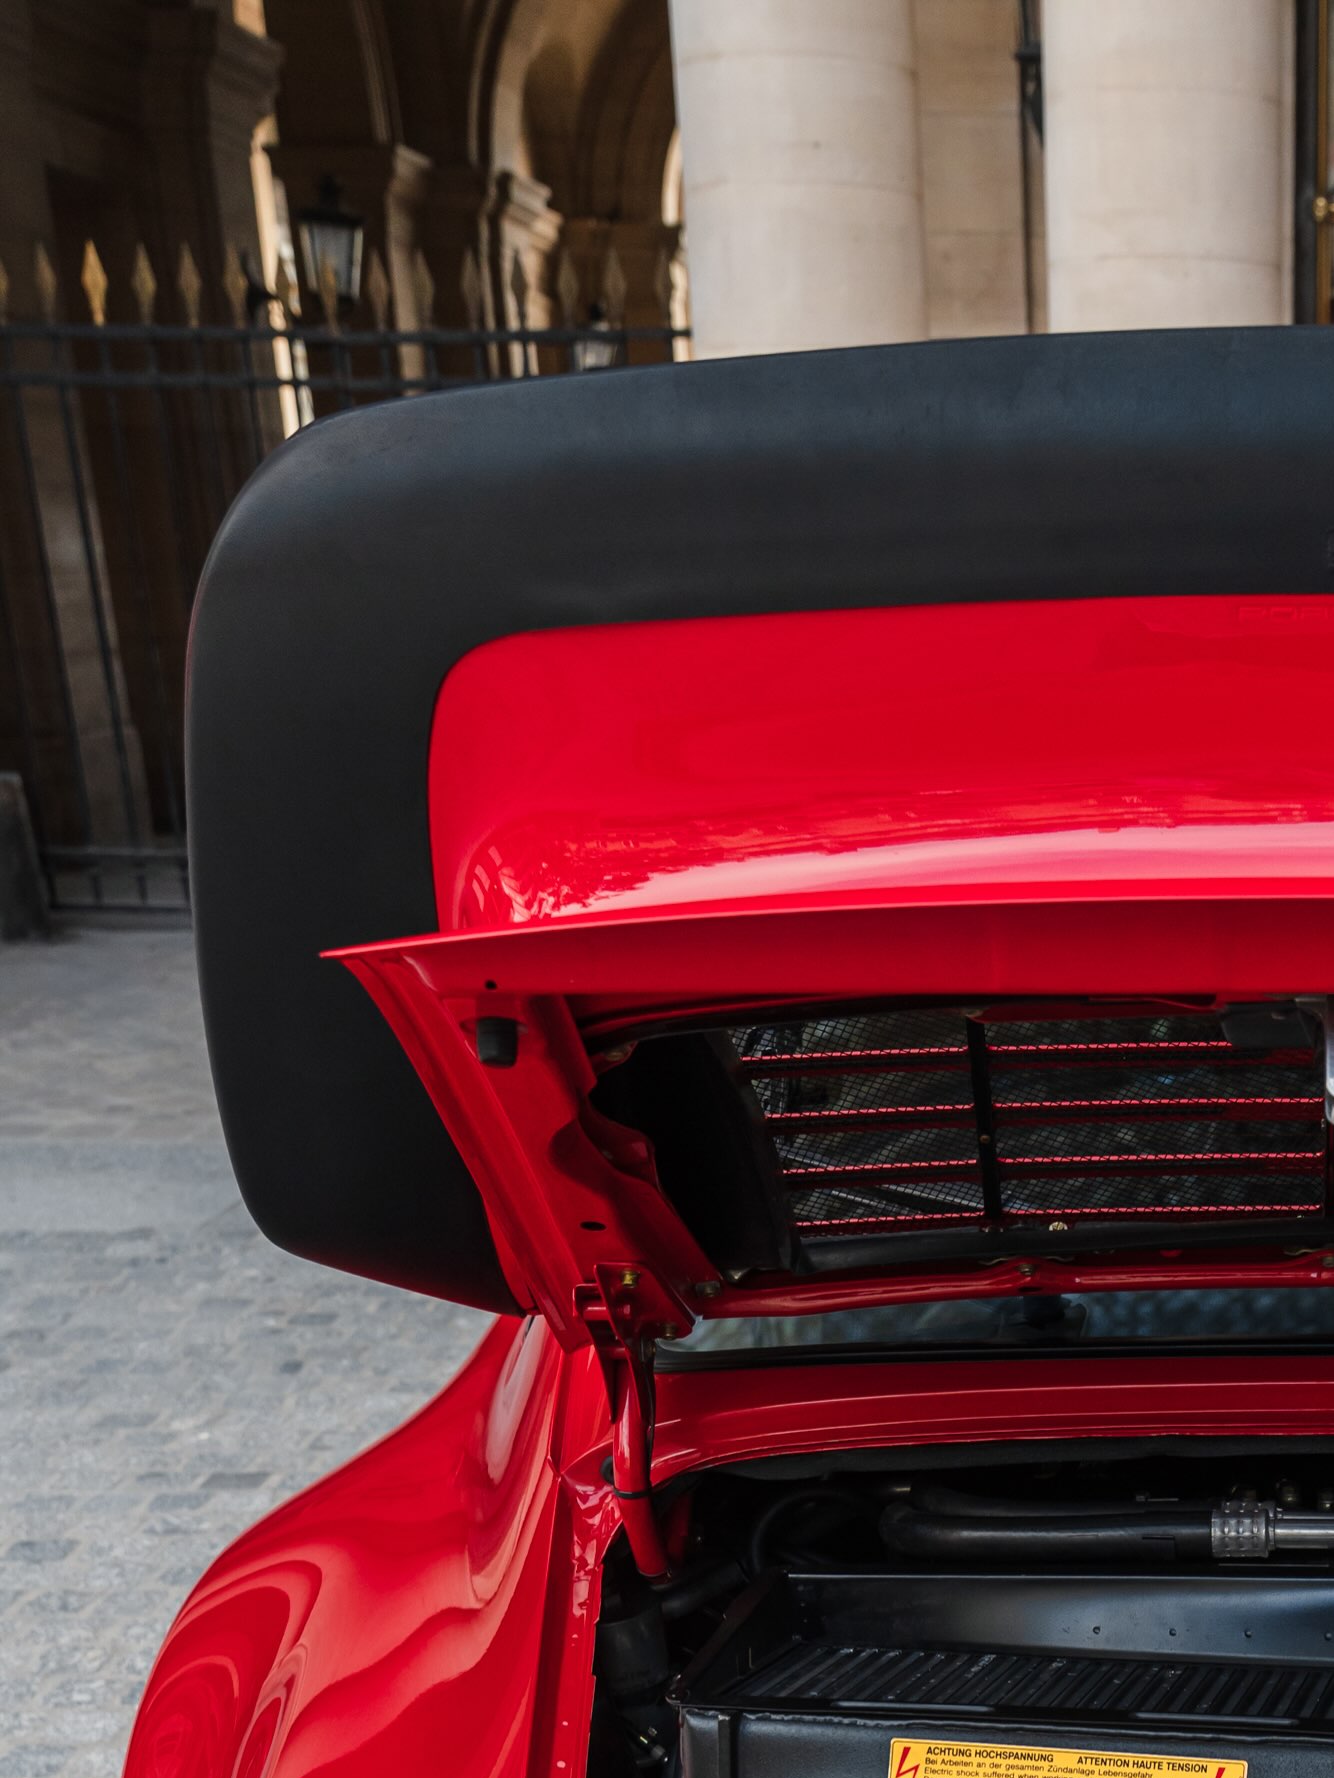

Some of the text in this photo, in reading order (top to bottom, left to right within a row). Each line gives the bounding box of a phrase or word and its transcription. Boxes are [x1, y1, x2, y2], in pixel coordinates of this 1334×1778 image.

[926, 1747, 1054, 1762] ACHTUNG HOCHSPANNUNG
[940, 1759, 973, 1767] Arbeiten
[989, 1761, 1002, 1769] der
[1005, 1763, 1044, 1772] gesamten
[1047, 1764, 1095, 1776] Zündanlage
[1098, 1769, 1153, 1778] Lebensgefahr
[1077, 1756, 1208, 1773] ATTENTION HAUTE TENSION
[925, 1768, 953, 1776] Electric
[956, 1769, 979, 1778] shock
[983, 1771, 1014, 1778] suffered
